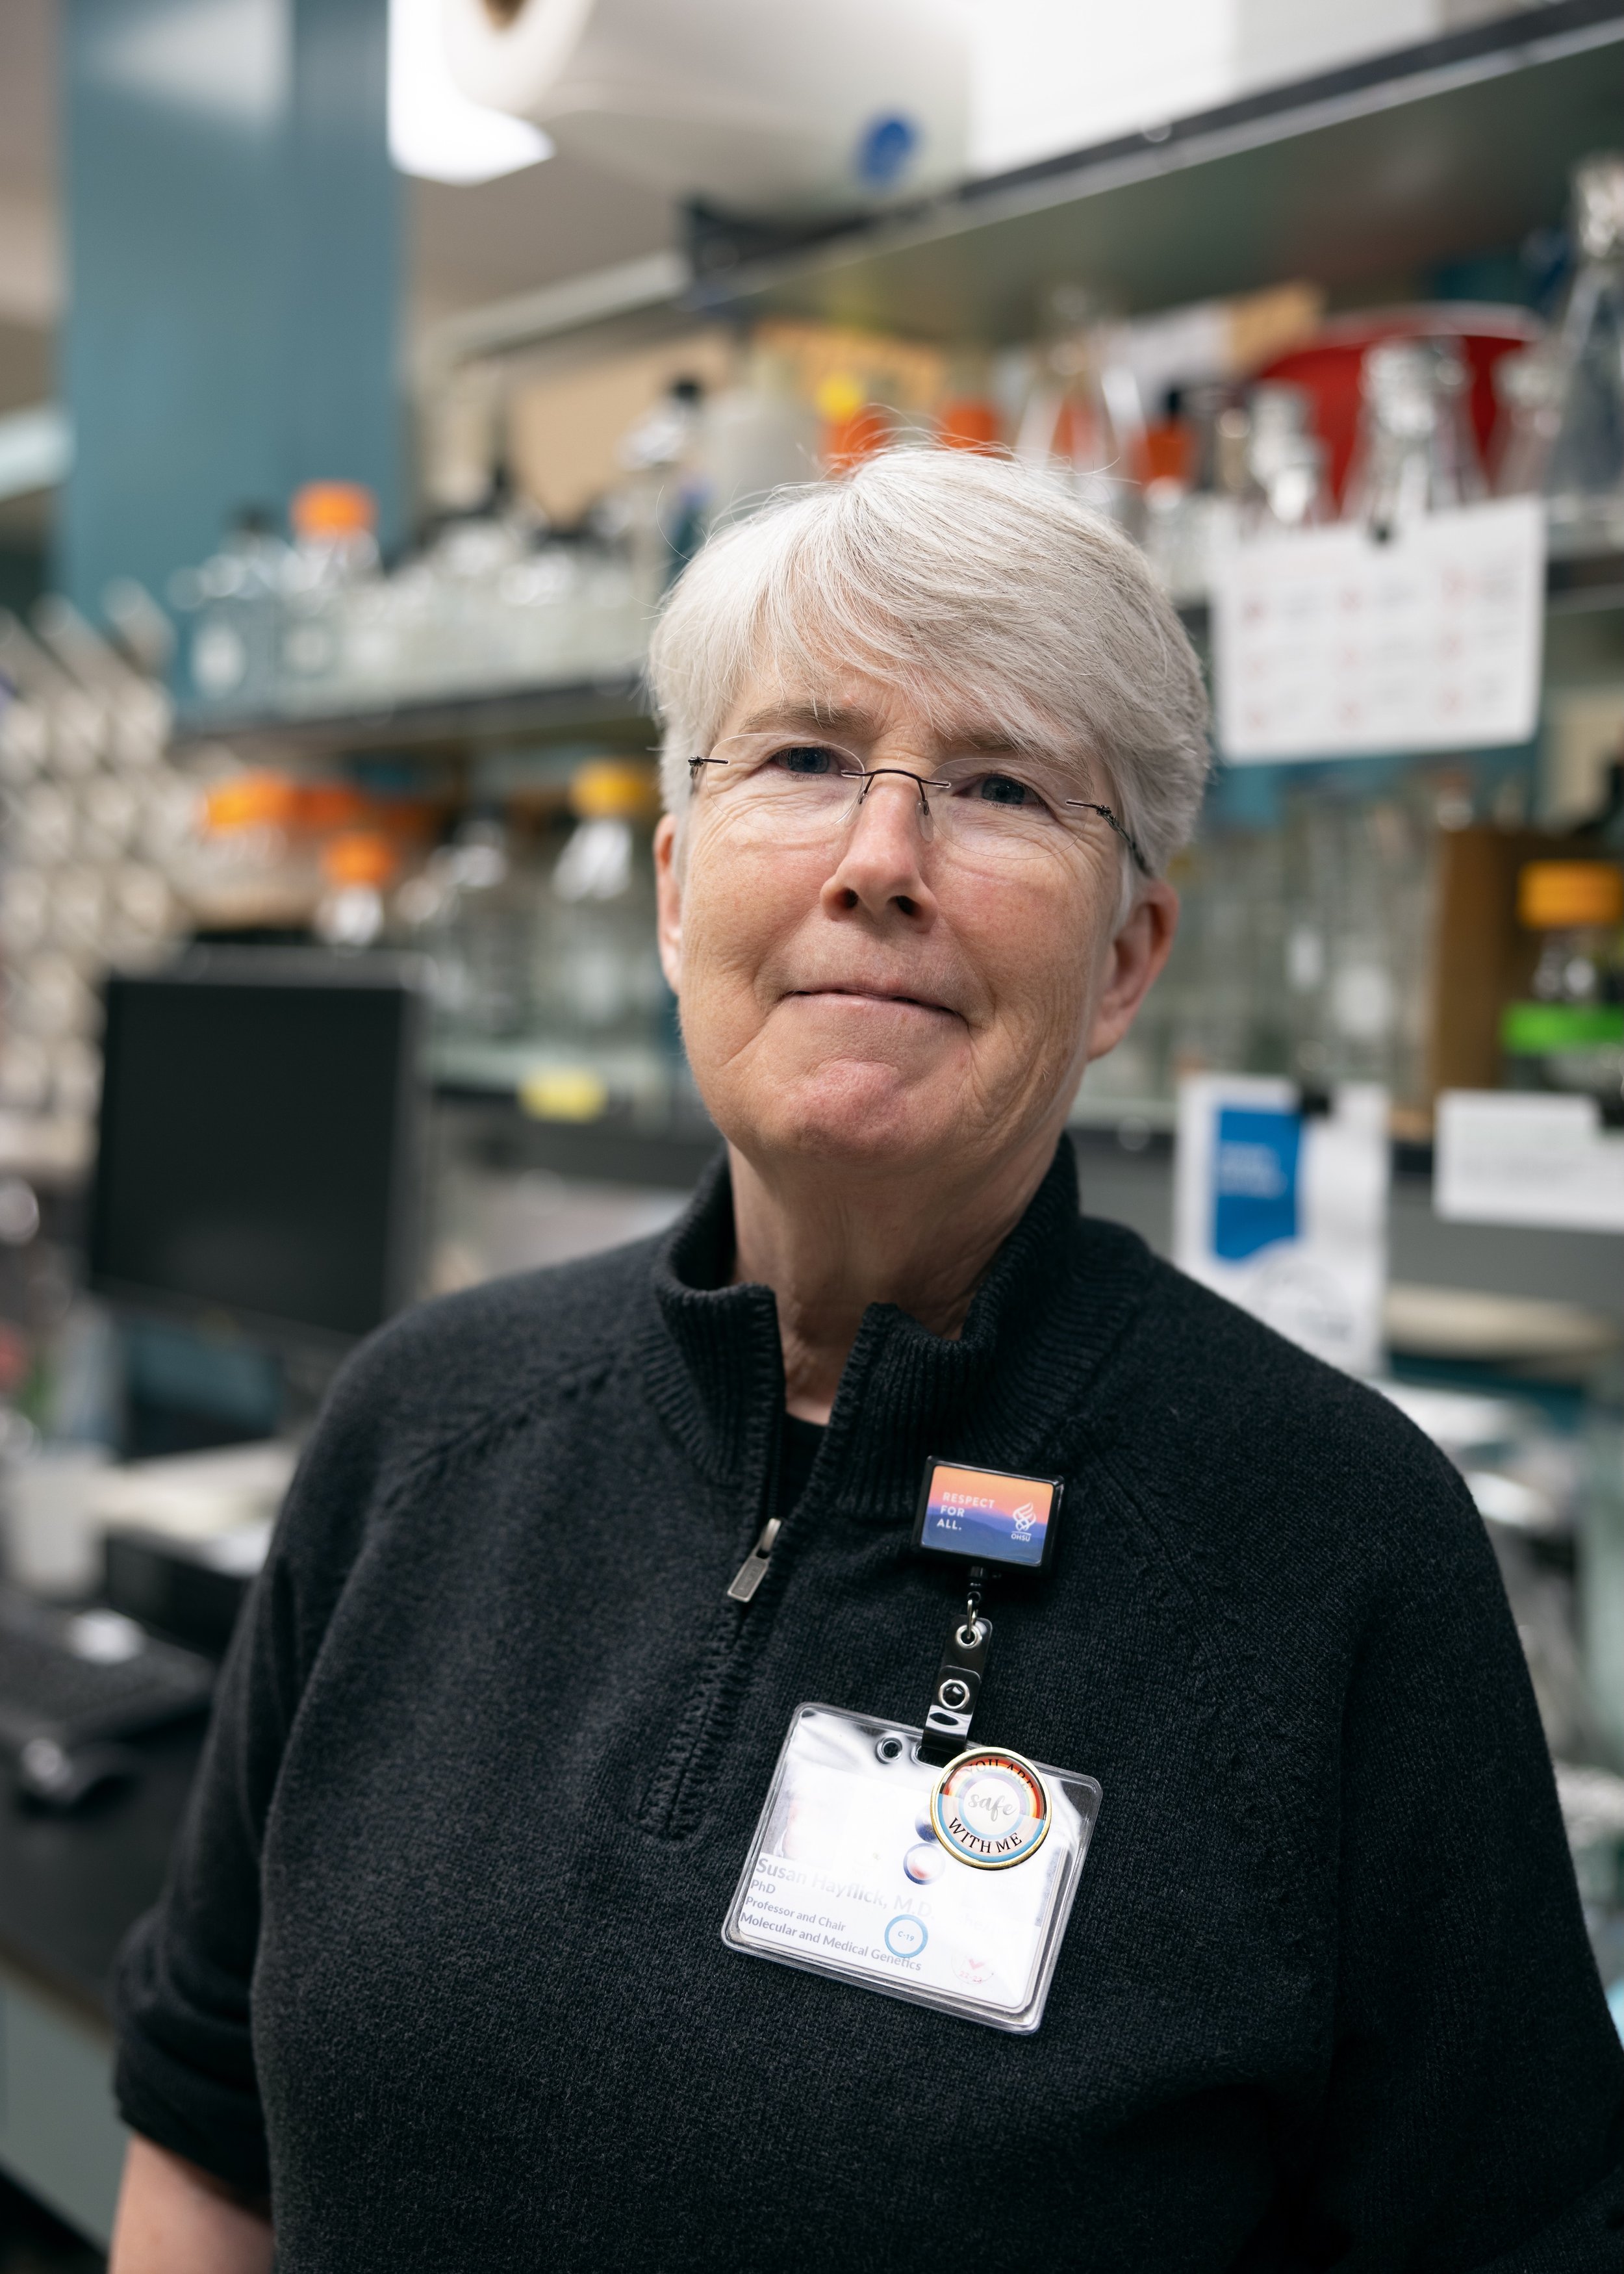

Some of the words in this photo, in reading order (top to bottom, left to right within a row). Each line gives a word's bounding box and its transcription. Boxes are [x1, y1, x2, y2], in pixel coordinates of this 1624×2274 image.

[940, 1505, 965, 1517] FOR
[943, 1492, 995, 1509] RESPECT
[937, 1518, 962, 1530] ALL.
[1011, 1533, 1030, 1542] OHSU
[965, 1758, 1000, 1776] YOU
[1002, 1763, 1034, 1792] ARE
[968, 1794, 1017, 1822] safe
[948, 1817, 991, 1853] WITH
[996, 1832, 1022, 1852] ME
[749, 1878, 776, 1895] PhD
[755, 1857, 807, 1885] Susan
[811, 1872, 888, 1910] Hayflick,
[744, 1896, 795, 1918] Professor
[796, 1909, 816, 1924] and
[818, 1916, 846, 1932] Chair
[740, 1911, 798, 1937] Molecular
[798, 1927, 820, 1943] and
[822, 1934, 869, 1957] Medical
[871, 1948, 922, 1972] Genetics
[897, 1930, 915, 1942] C-19
